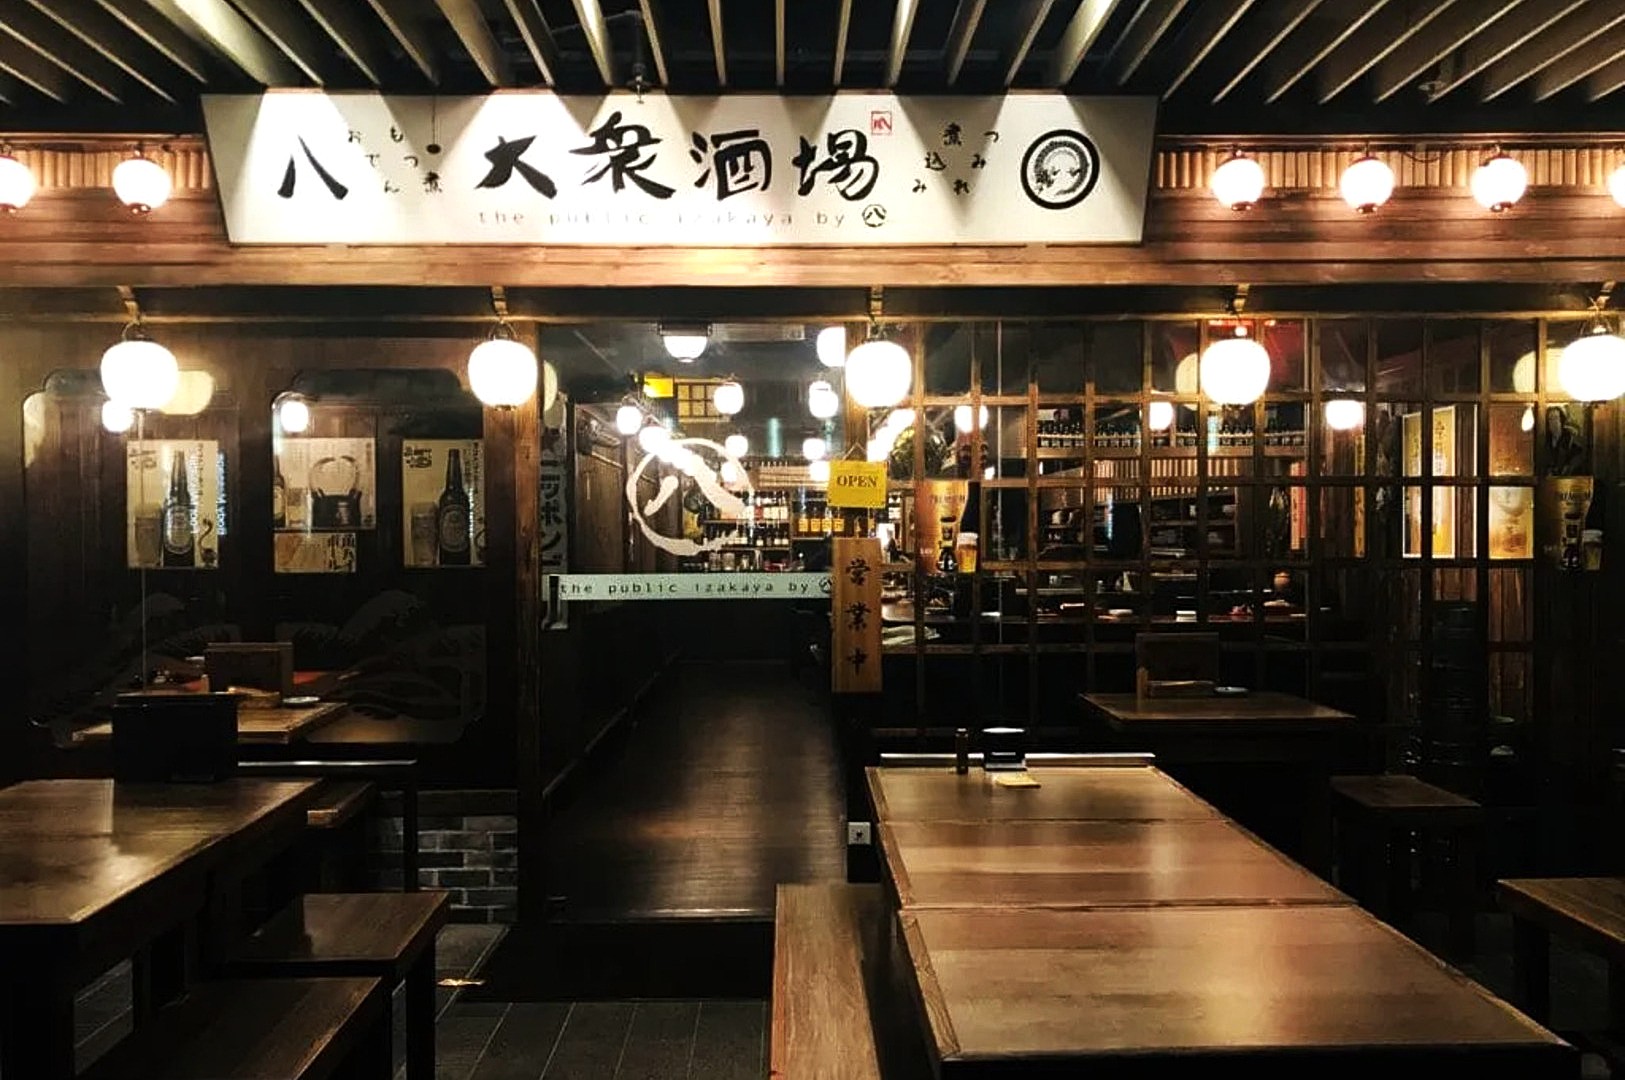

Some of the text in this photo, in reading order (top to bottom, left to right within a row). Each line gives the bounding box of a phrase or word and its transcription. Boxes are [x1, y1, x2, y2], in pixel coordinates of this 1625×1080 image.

[473, 111, 880, 201] 大衆酒場
[816, 211, 845, 228] by
[836, 474, 879, 489] OPEN
[560, 583, 593, 594] the
[608, 583, 678, 596] public
[695, 581, 775, 594] izakaya
[789, 581, 809, 595] by
